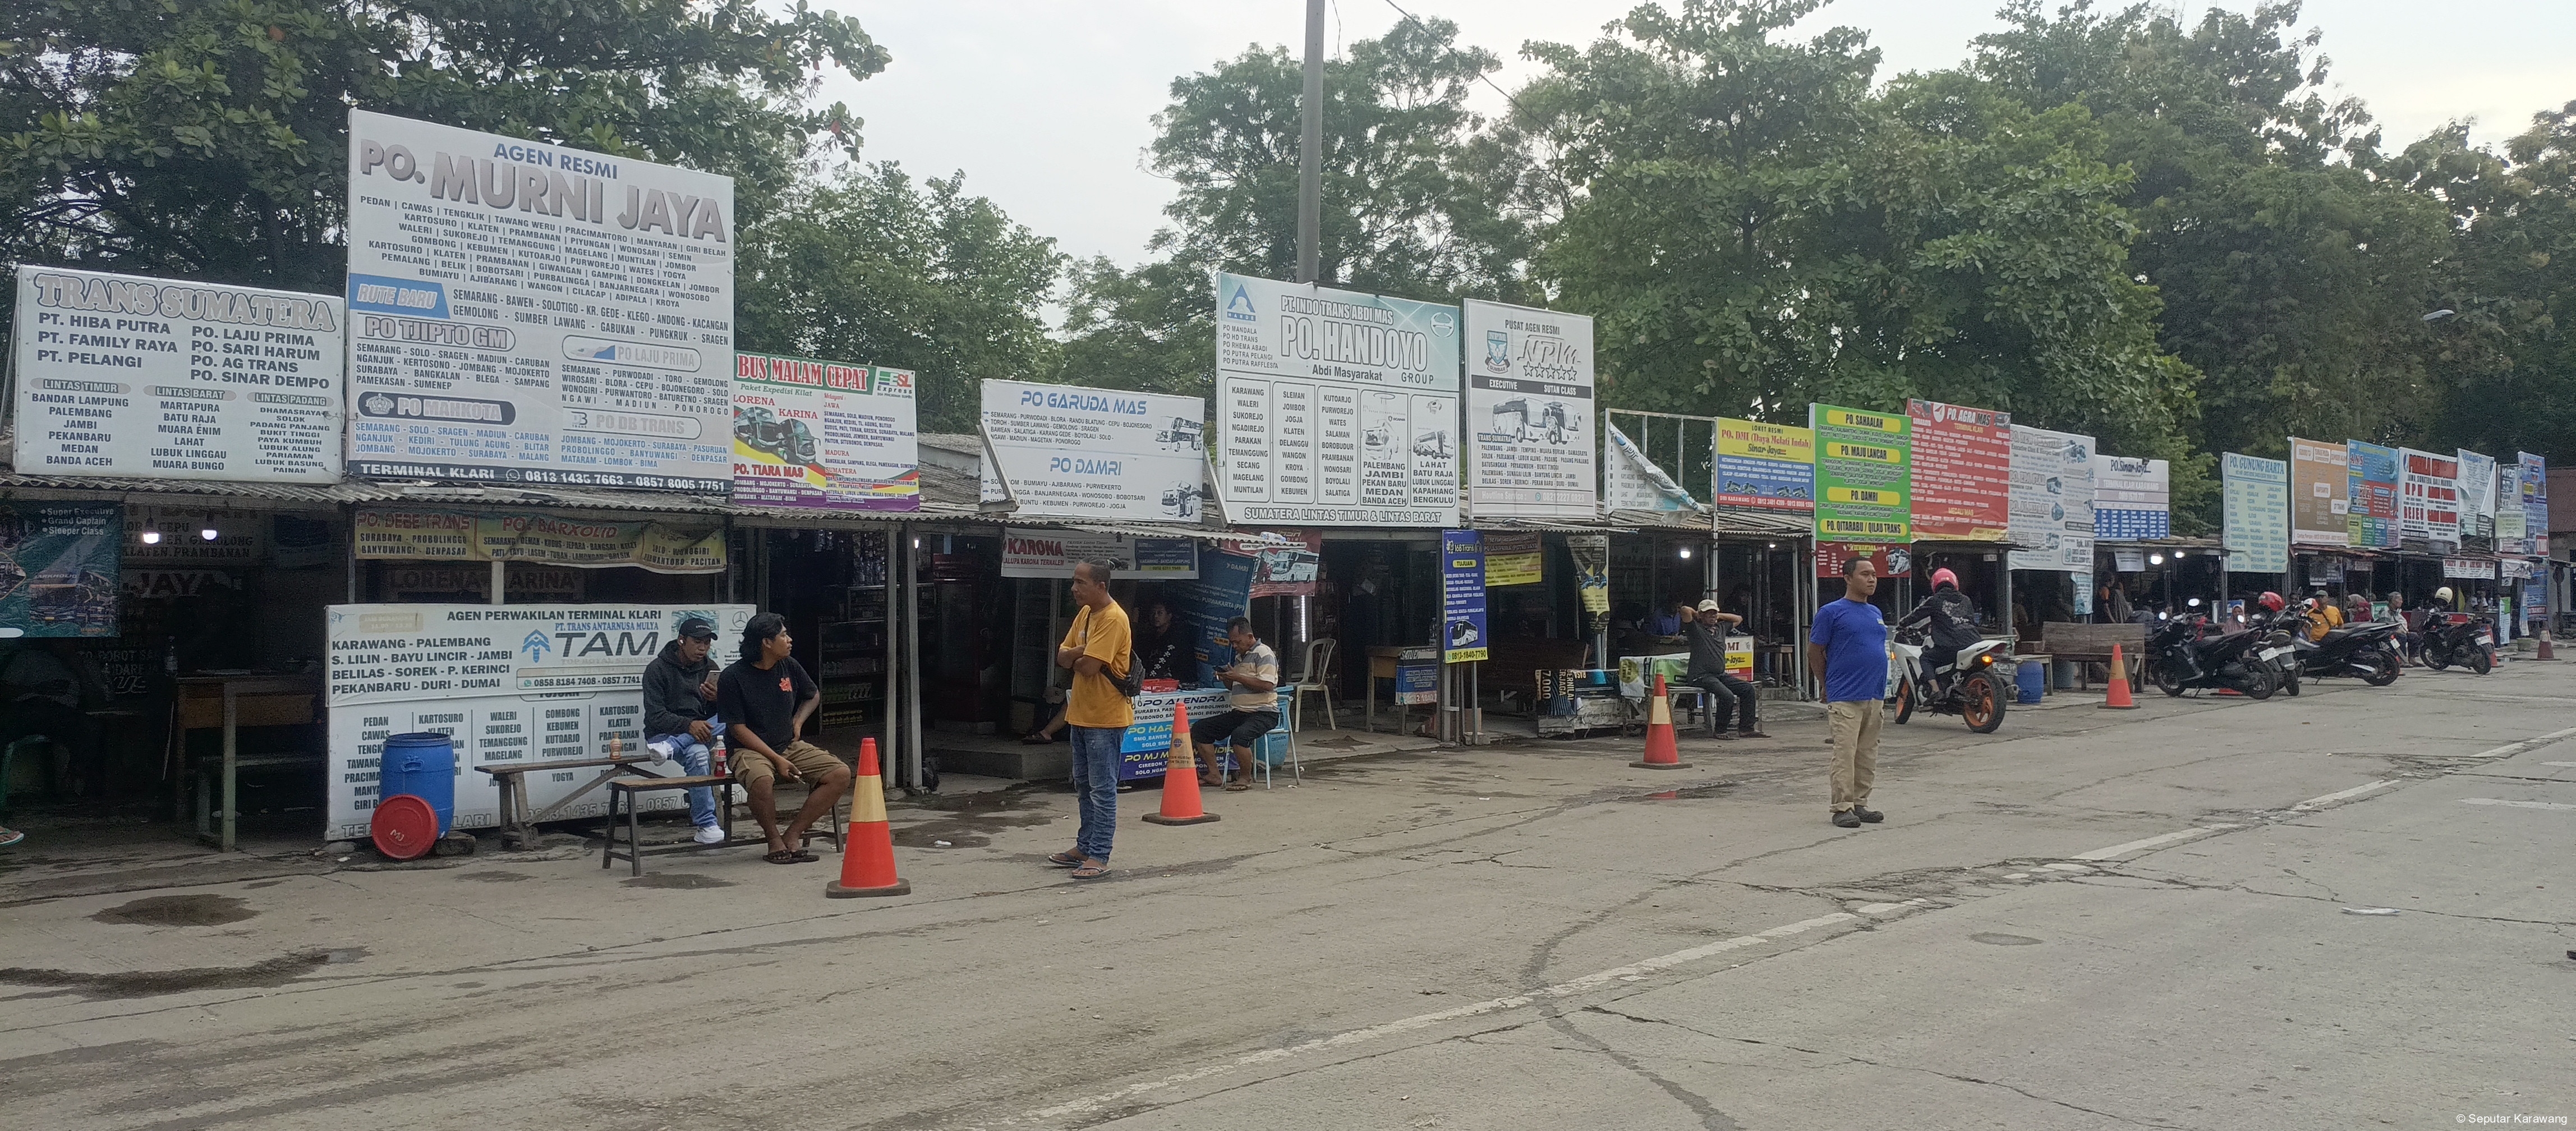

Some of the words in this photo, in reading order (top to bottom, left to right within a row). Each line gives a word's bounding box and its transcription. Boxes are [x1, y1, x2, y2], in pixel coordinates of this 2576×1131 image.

[494, 143, 553, 167] AGEN
[561, 154, 618, 179] RESMI
[361, 140, 426, 183] PO.
[430, 151, 605, 223] MURNI
[617, 185, 726, 242] JAYA
[360, 196, 391, 206] PEDAN
[401, 202, 433, 213] CAWAS
[443, 208, 485, 221] TENGKLIK
[494, 215, 528, 227] TAWANG
[531, 221, 555, 231] WERU
[565, 226, 628, 243] PRACIMANTORO
[636, 238, 677, 251] MANYARAN
[686, 245, 701, 254] GIRI
[703, 247, 726, 257] BELAH
[34, 274, 156, 316] TRANS
[160, 286, 336, 332] SUMATERA
[1320, 301, 1350, 319] TRANS
[1351, 305, 1374, 322] ABDI
[1374, 307, 1394, 325] MAS
[38, 312, 64, 326] PT.
[70, 315, 111, 330] HIBA
[116, 319, 171, 334] PUTRA
[1505, 320, 1524, 330] PUSAT
[1525, 321, 1540, 333] AGEN
[1542, 323, 1560, 335] RESMI
[192, 325, 218, 338] PO.
[223, 328, 260, 342] LAJU
[265, 332, 314, 346] PRIMA
[365, 316, 395, 337] PO
[398, 320, 470, 346] TJIPTO
[473, 327, 508, 348] GM
[1281, 316, 1319, 359] PO.
[1324, 320, 1428, 371] HANDOYO
[738, 355, 766, 379] BUS
[772, 358, 822, 385] MALAM
[826, 366, 867, 389] CEPAT
[1312, 364, 1332, 375] Abdi
[1334, 366, 1382, 381] Masyarakat
[1401, 373, 1434, 385] GROUP
[763, 386, 793, 396] Expedisi
[877, 385, 912, 394] Express
[1232, 387, 1264, 396] KARAWANG
[1489, 379, 1517, 390] EXECUTIVE
[1544, 384, 1558, 394] SUTAN
[1560, 385, 1576, 396] CLASS
[255, 393, 287, 404] LINTAS
[289, 395, 326, 406] PADANG
[733, 394, 775, 406] LORENA
[1283, 391, 1305, 399] SLEMAN
[160, 401, 220, 412] MARTAPURA
[1021, 391, 1043, 407] PO
[1047, 393, 1108, 412] GARUDA
[1113, 398, 1147, 415] MAS
[49, 407, 112, 418] PALEMBANG
[397, 398, 422, 414] PO
[424, 399, 502, 421] MAHKOTA
[779, 408, 818, 419] KARINA
[1846, 414, 1855, 424] PO.
[1947, 408, 1958, 421] PO.
[1958, 411, 1976, 424] AGRA
[1976, 413, 1990, 426] MAS
[64, 419, 97, 429] JAMBI
[1722, 430, 1733, 439] PO.
[1229, 449, 1268, 457] TEMANGGUNG
[1841, 445, 1850, 456] PO.
[1851, 447, 1866, 457] MAJU
[1867, 449, 1887, 459] LANCAR
[734, 464, 749, 475] PO.
[752, 465, 781, 476] TIARA
[783, 466, 804, 477] MAS
[1050, 457, 1071, 472] PO
[1075, 461, 1122, 475] DAMRI
[1364, 461, 1405, 470] PALEMBANG
[2230, 456, 2238, 467] PO.
[2239, 457, 2265, 472] GUNUNG
[2265, 461, 2284, 474] HARTA
[361, 463, 445, 477] TERMINAL
[449, 466, 495, 479] KLARI
[525, 471, 558, 482] 0813
[594, 474, 623, 485] 7663
[636, 476, 664, 486] 0857
[668, 478, 696, 489] 8005
[698, 479, 725, 491] 7751
[1851, 490, 1860, 500] PO.
[1861, 491, 1878, 502] DAMRI
[1244, 507, 1300, 520] SUMATERA
[1301, 508, 1336, 521] LINTAS
[1338, 509, 1368, 521] TIMUR
[1370, 511, 1378, 521] &
[1380, 511, 1412, 522] LINTAS
[1414, 511, 1442, 523] BARAT
[76, 517, 106, 526] Captain
[1827, 520, 1836, 531] PO.
[1884, 523, 1901, 534] TRANS
[49, 527, 79, 536] Sleeper
[360, 534, 402, 542] SURABAYA
[1008, 539, 1064, 556] KARONA
[1202, 597, 1234, 608] PURWAKARTA
[447, 612, 481, 621] AGEN
[485, 611, 564, 621] PERWAKILAN
[567, 610, 626, 620] TERMINAL
[629, 610, 661, 619] KLARI
[555, 623, 566, 631] PT.
[567, 623, 592, 631] TRANS
[593, 622, 635, 631] ANTARNUSA
[636, 622, 659, 630] MULYA
[555, 632, 659, 658] TAM
[1452, 650, 1486, 660] 0813-1840-7790
[1542, 670, 1551, 699] 7.000
[419, 713, 464, 724] KARTOSURO
[546, 708, 580, 718] GOMBONG
[480, 736, 528, 747] TEMANGGUNG
[599, 730, 640, 741] PRABANAN
[552, 772, 574, 782] YOGYA
